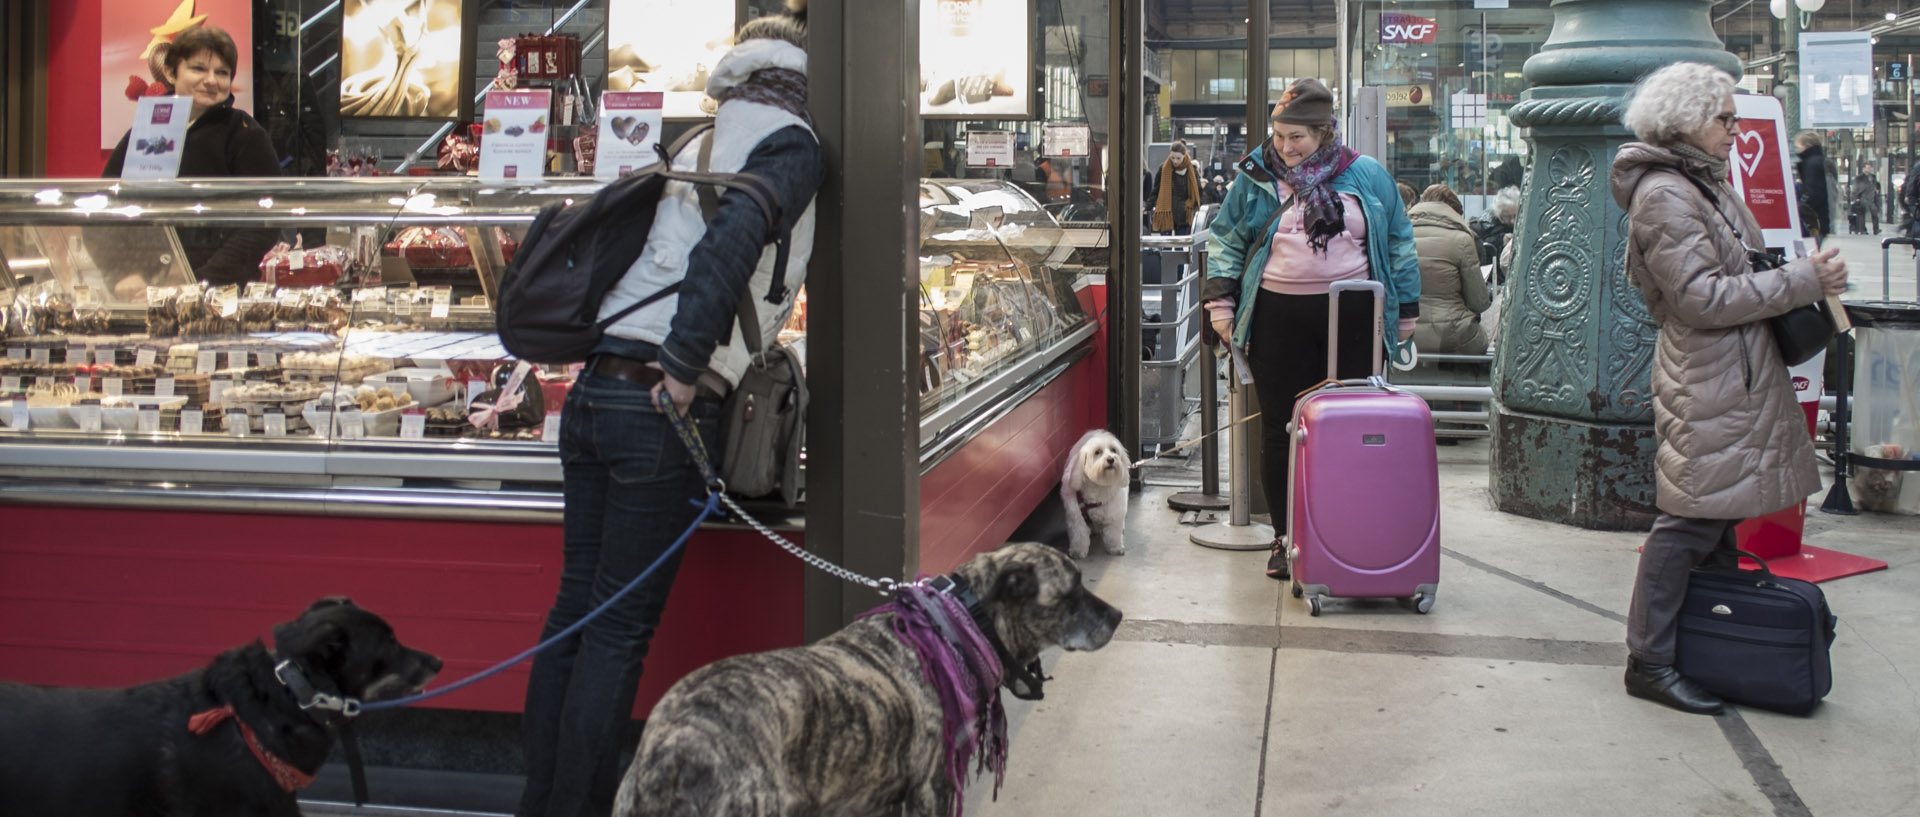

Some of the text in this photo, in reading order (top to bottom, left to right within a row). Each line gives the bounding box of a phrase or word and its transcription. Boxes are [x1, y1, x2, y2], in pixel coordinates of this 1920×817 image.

[1382, 24, 1434, 40] SNCF
[1893, 68, 1900, 78] 6
[504, 96, 531, 105] NEW
